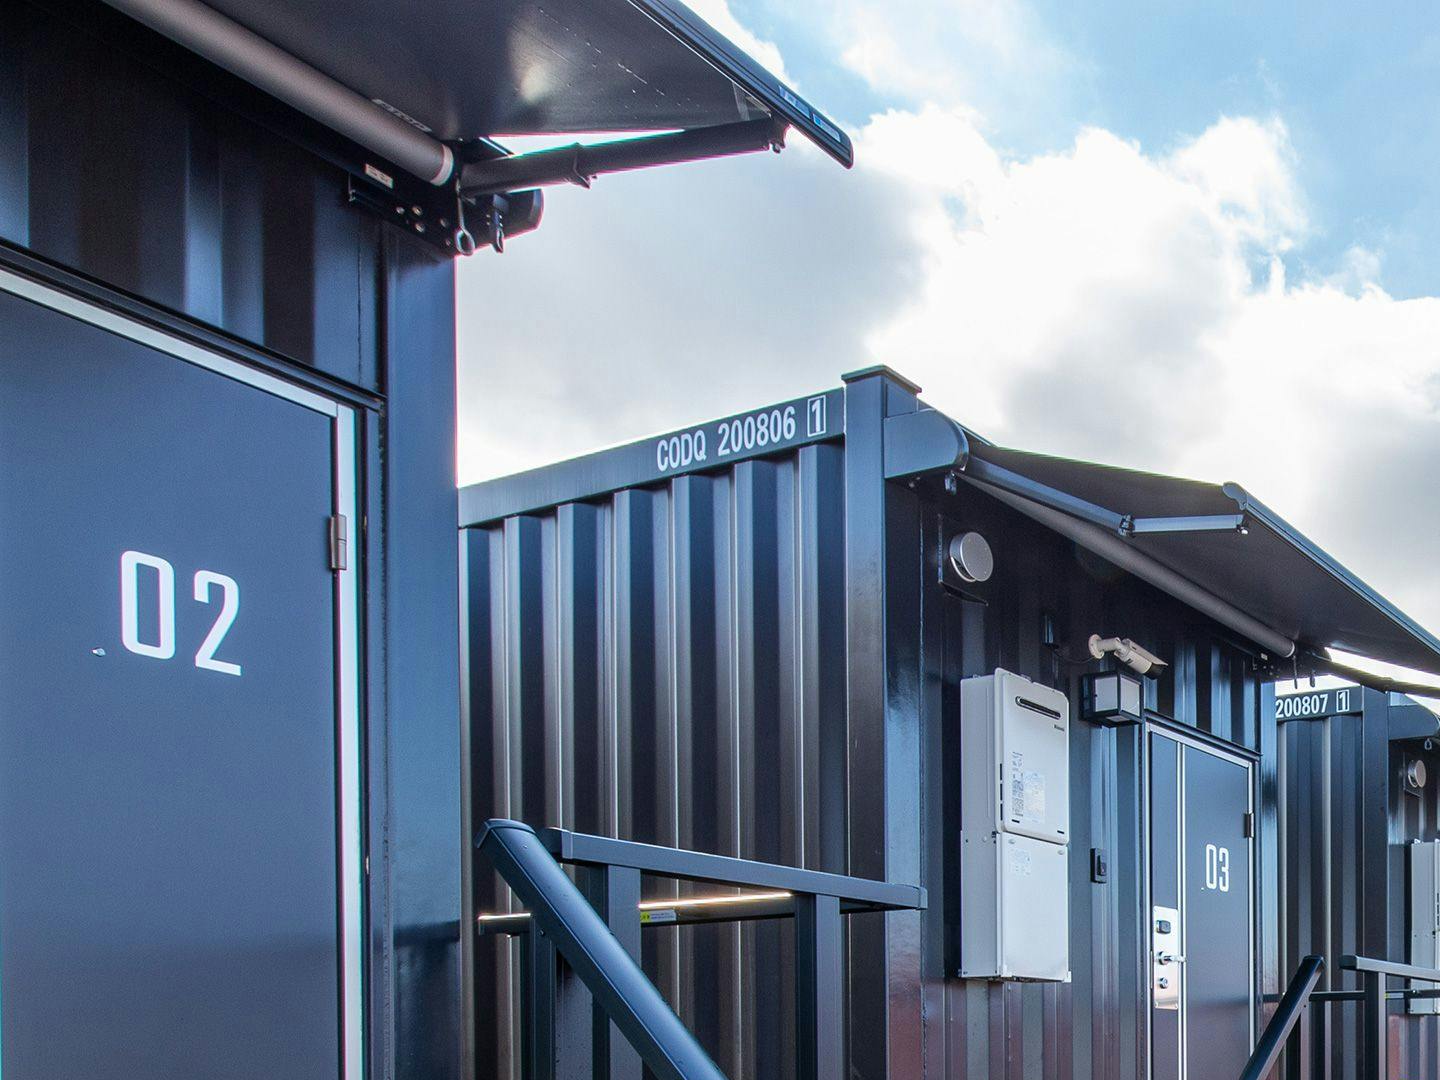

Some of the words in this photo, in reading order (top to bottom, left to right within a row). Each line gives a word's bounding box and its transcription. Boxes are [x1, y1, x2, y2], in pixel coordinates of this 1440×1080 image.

[656, 430, 707, 472] CODQ
[717, 405, 796, 457] 200806
[120, 550, 242, 676] 02
[1275, 694, 1329, 718] 200807
[1205, 843, 1230, 892] 03
